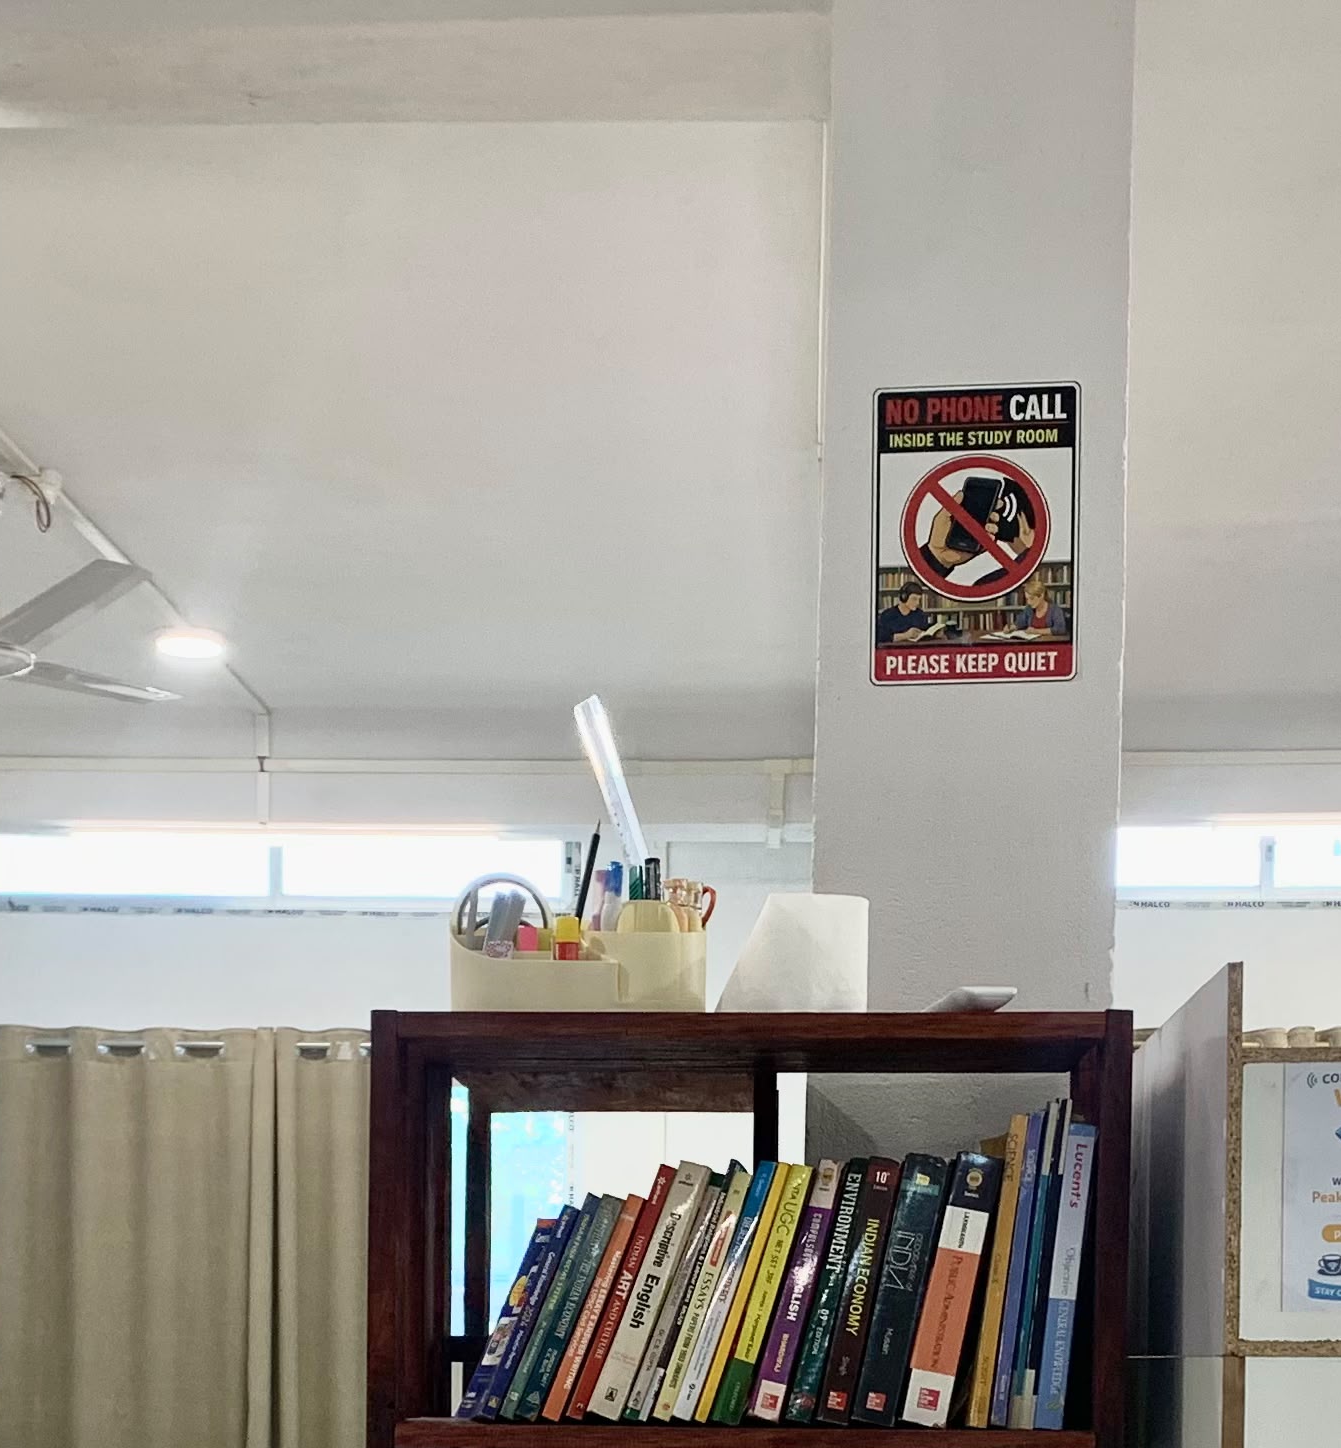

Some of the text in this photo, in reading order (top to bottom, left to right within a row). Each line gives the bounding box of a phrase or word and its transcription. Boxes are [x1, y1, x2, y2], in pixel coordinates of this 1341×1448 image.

[885, 394, 1067, 425] NO PHONE CALL
[889, 429, 1058, 448] INSIDE THE STUDY ROOM
[885, 651, 1058, 675] PLEASE KEEP QUIET
[1003, 1133, 1018, 1181] SCIENCE
[1068, 1143, 1086, 1209] Lucent's
[651, 1211, 682, 1269] Descriptive
[775, 1200, 797, 1236] UGC
[826, 1171, 861, 1273] ENVIRONMENT
[844, 1218, 880, 1336] INDIAN ECONOMY
[884, 1229, 915, 1290] INDIA
[593, 1234, 646, 1360] INDIAN ART AND CULTURE
[626, 1272, 661, 1331] English
[692, 1271, 714, 1310] ESSAYS
[553, 1300, 576, 1339] ECONOMY
